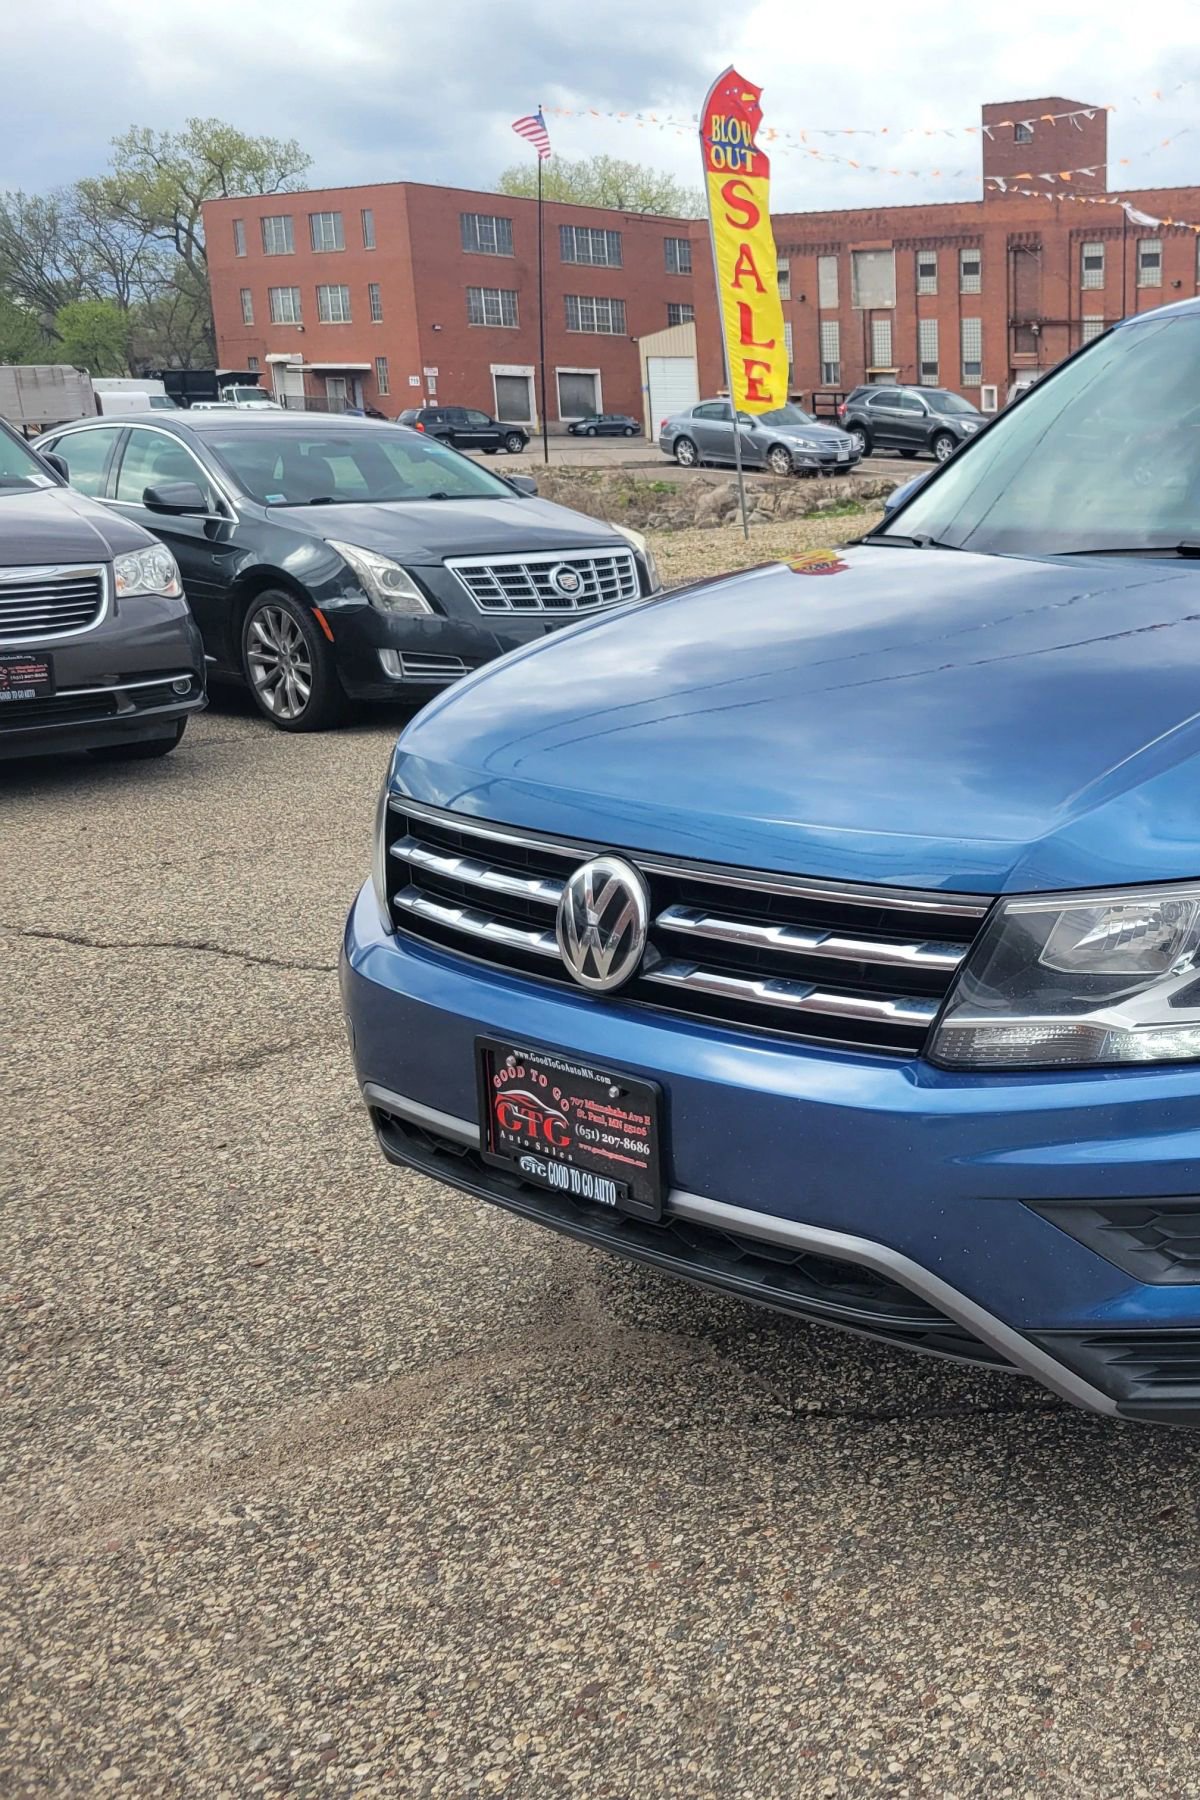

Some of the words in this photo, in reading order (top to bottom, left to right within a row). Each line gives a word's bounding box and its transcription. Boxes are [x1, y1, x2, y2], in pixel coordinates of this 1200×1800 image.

[710, 144, 758, 172] OUT
[720, 178, 776, 404] SALE
[493, 1065, 526, 1088] GOOD
[530, 1068, 548, 1088] TO
[552, 1087, 570, 1112] GO
[500, 1129, 530, 1147] Auto
[535, 1142, 573, 1161] Sales
[575, 1123, 600, 1142] (651)
[601, 1133, 651, 1156] 207-8686
[548, 1161, 570, 1189] GOOD
[569, 1168, 581, 1194] TO
[581, 1173, 594, 1198] GO
[594, 1176, 617, 1206] AUTO
